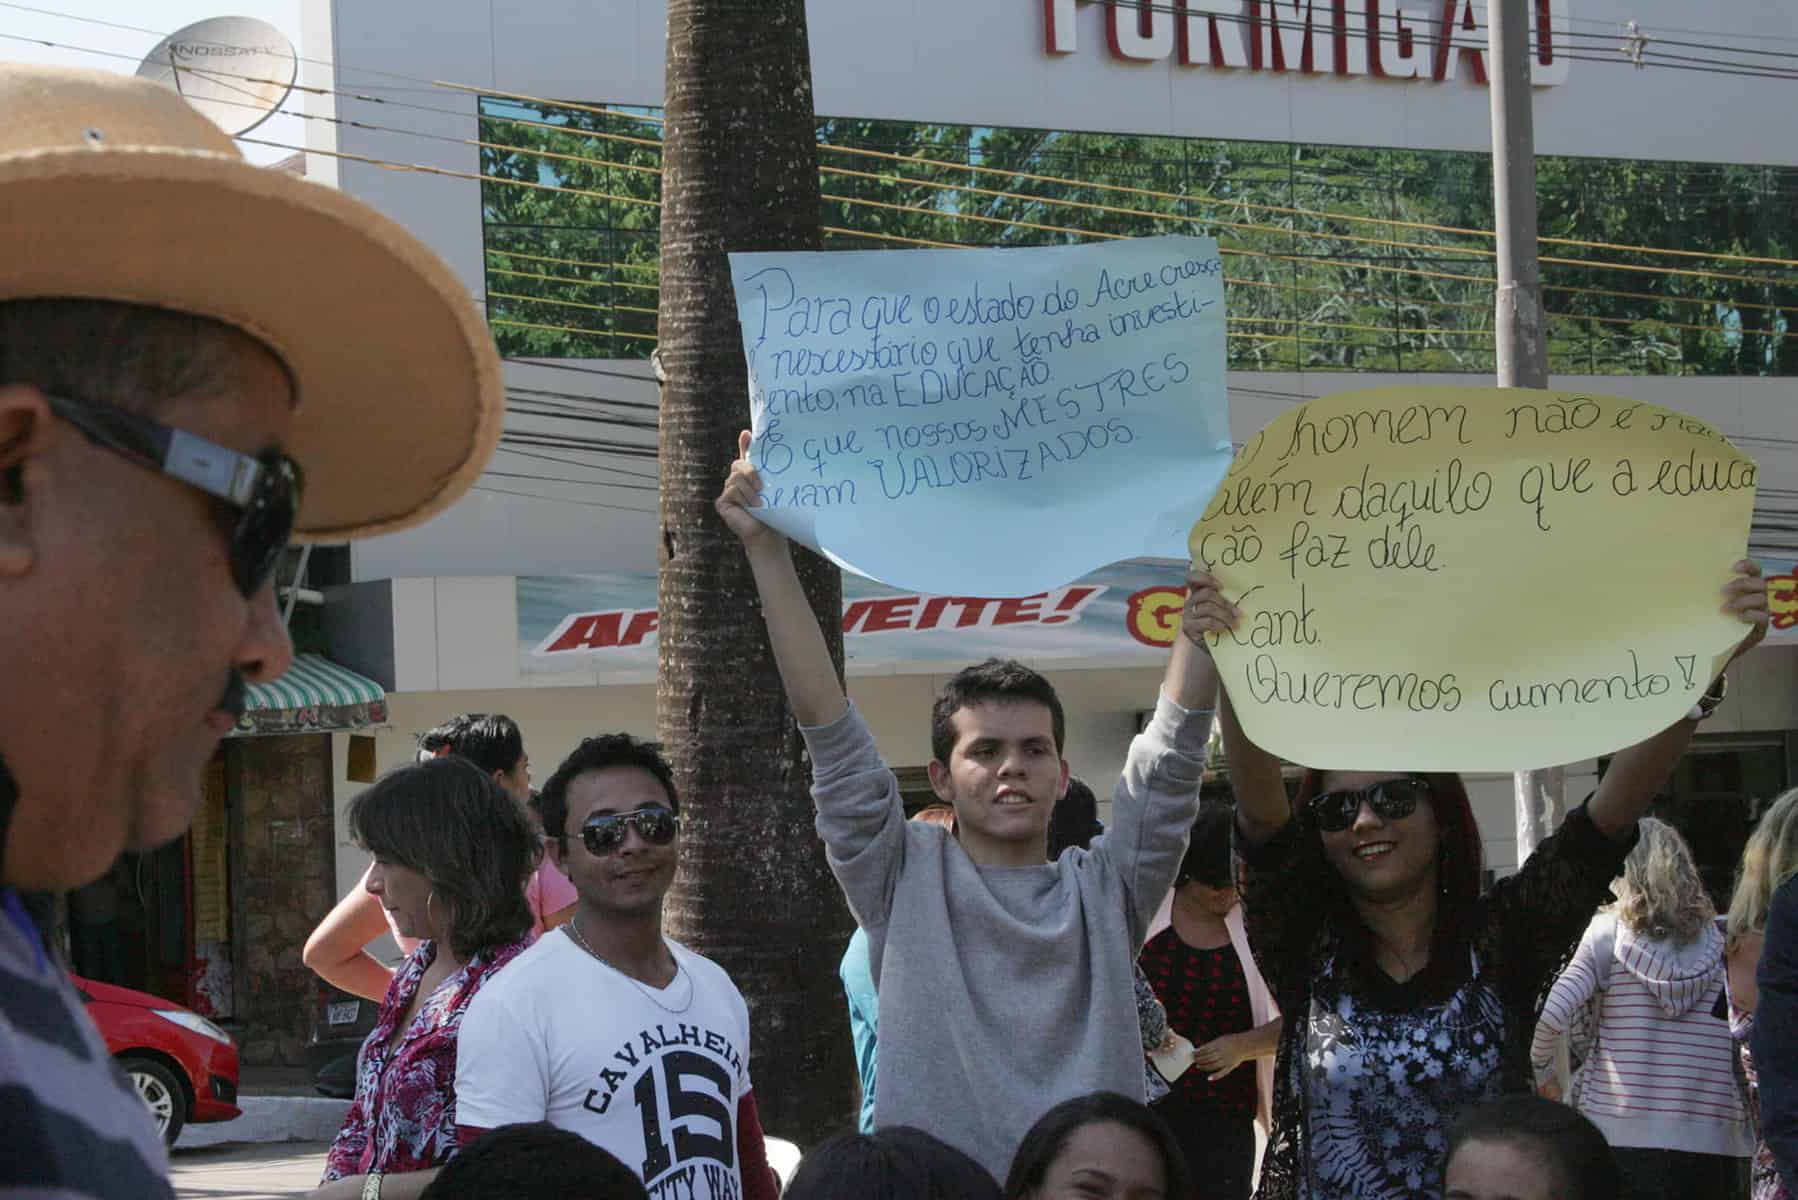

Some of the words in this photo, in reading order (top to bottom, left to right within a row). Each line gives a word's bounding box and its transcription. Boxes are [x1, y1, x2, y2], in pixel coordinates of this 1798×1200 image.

[743, 267, 852, 338] Para
[861, 294, 913, 364] que
[946, 280, 1034, 325] estado
[1042, 280, 1079, 316] do
[1086, 268, 1156, 308] Acre
[946, 336, 1000, 368] que
[1014, 319, 1101, 358] tenha
[1108, 291, 1215, 337] investi-
[802, 430, 864, 479] que
[874, 418, 987, 450] nossos
[992, 352, 1189, 440] MESTRES
[1277, 405, 1472, 462] homem
[1504, 397, 1601, 438] não
[1332, 458, 1492, 532] daquilo
[1519, 457, 1594, 531] que
[1612, 458, 1638, 496] a
[1647, 448, 1757, 497] educa
[1201, 524, 1263, 573] ção
[1280, 521, 1351, 579] faz
[1246, 654, 1462, 712] Queremos
[634, 1050, 733, 1185] 15
